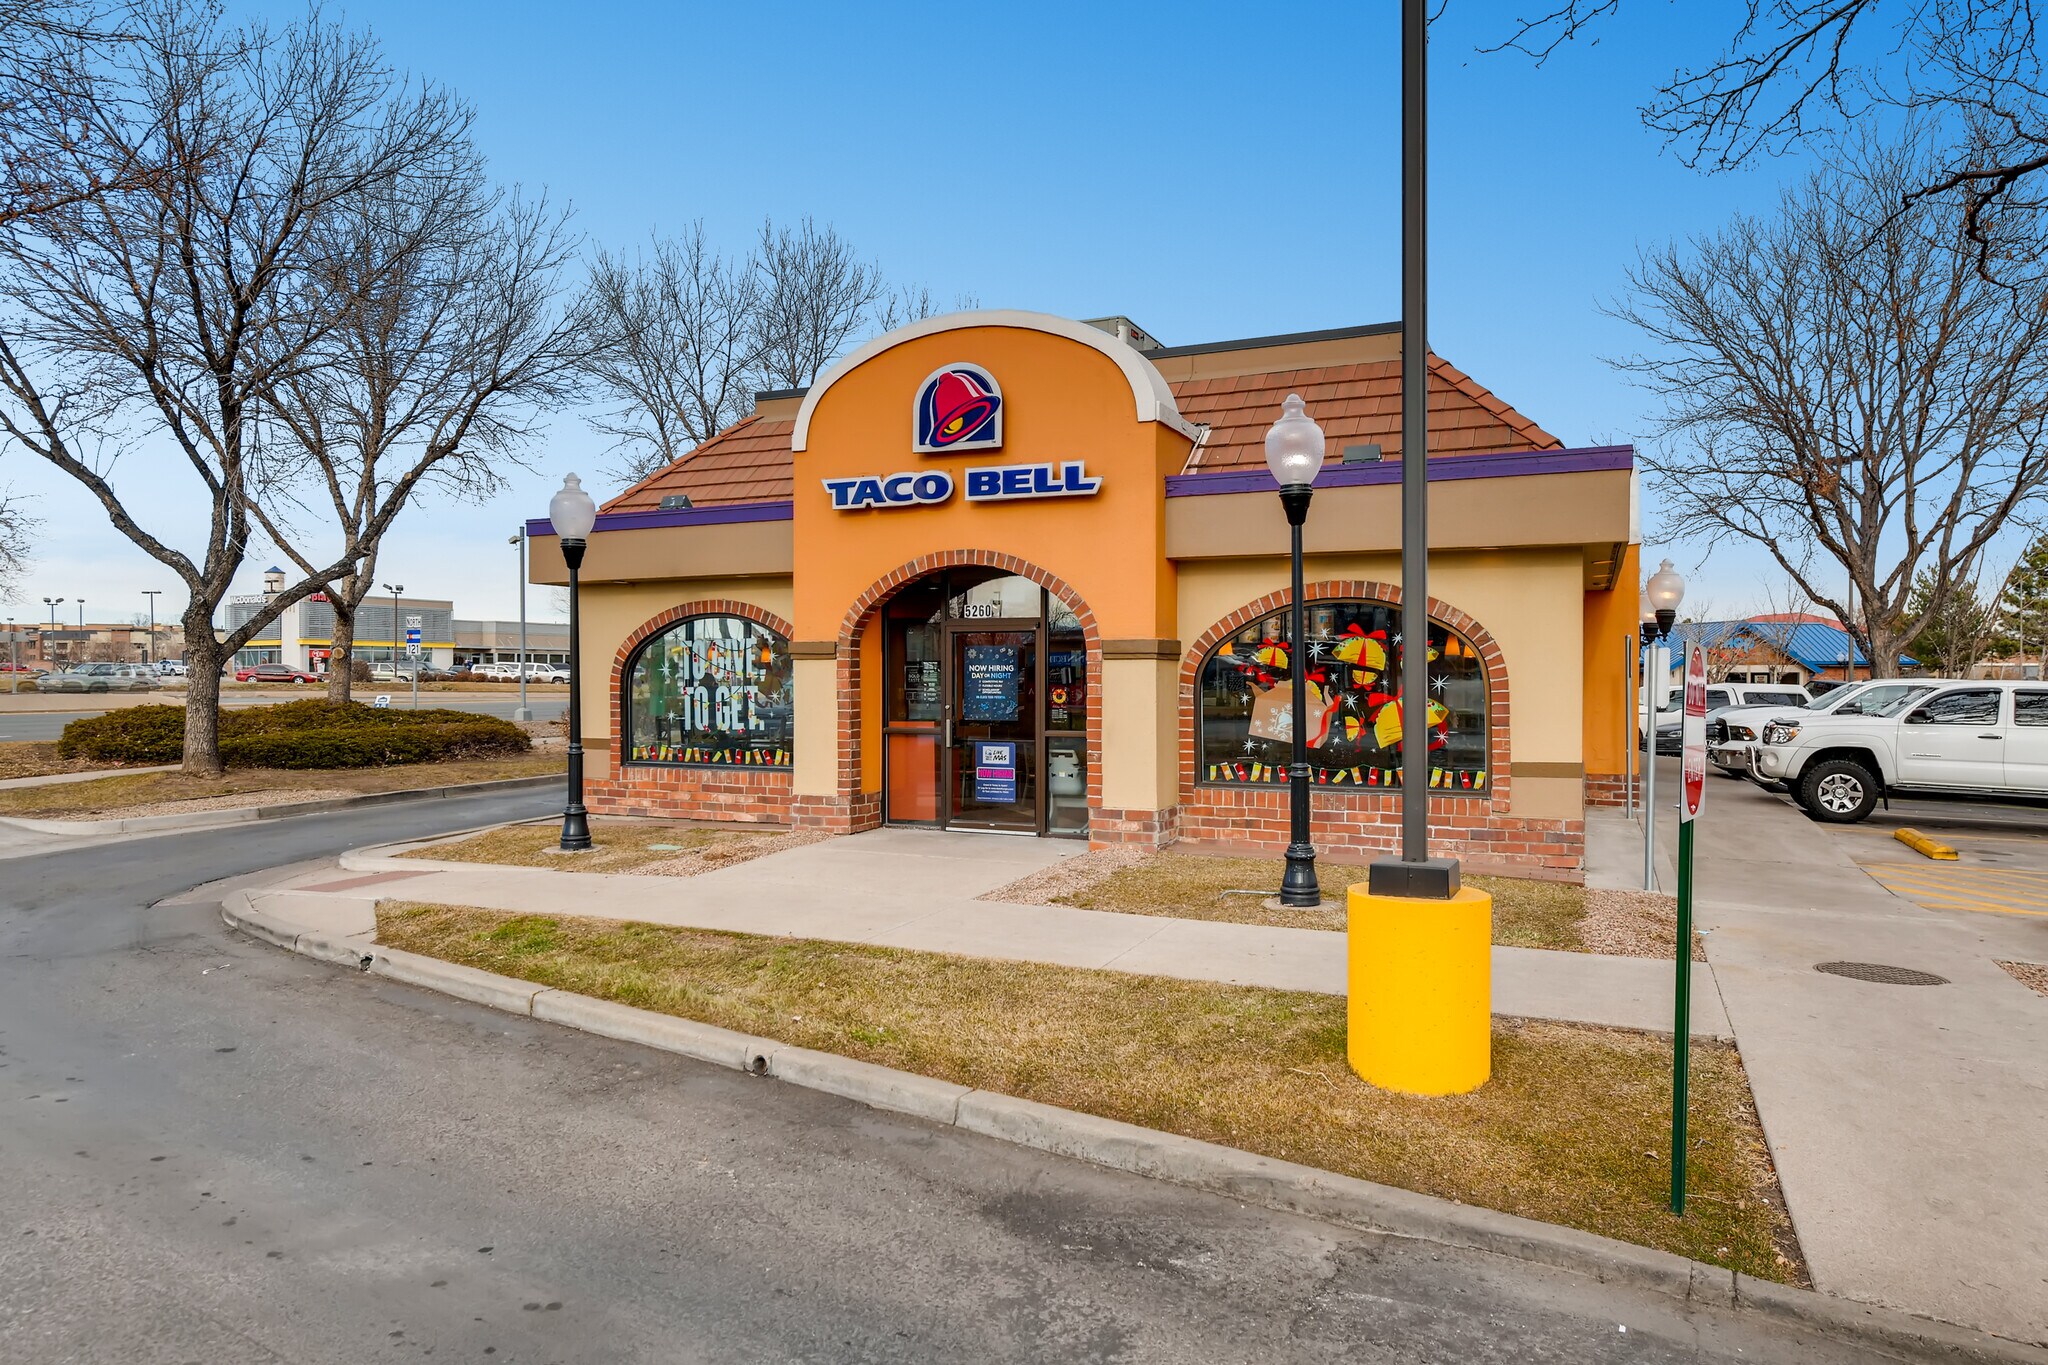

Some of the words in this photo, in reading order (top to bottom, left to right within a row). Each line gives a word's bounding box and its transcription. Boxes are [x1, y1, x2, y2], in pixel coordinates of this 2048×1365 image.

[826, 474, 950, 506] TACO
[967, 465, 1097, 497] BELL
[231, 594, 267, 605] McDonald's
[965, 604, 991, 617] 5260
[406, 618, 421, 627] NORTH
[408, 644, 419, 654] 121
[681, 639, 706, 680] TO
[969, 664, 987, 672] NOW
[988, 664, 1014, 672] HIRING
[682, 686, 708, 731] TO
